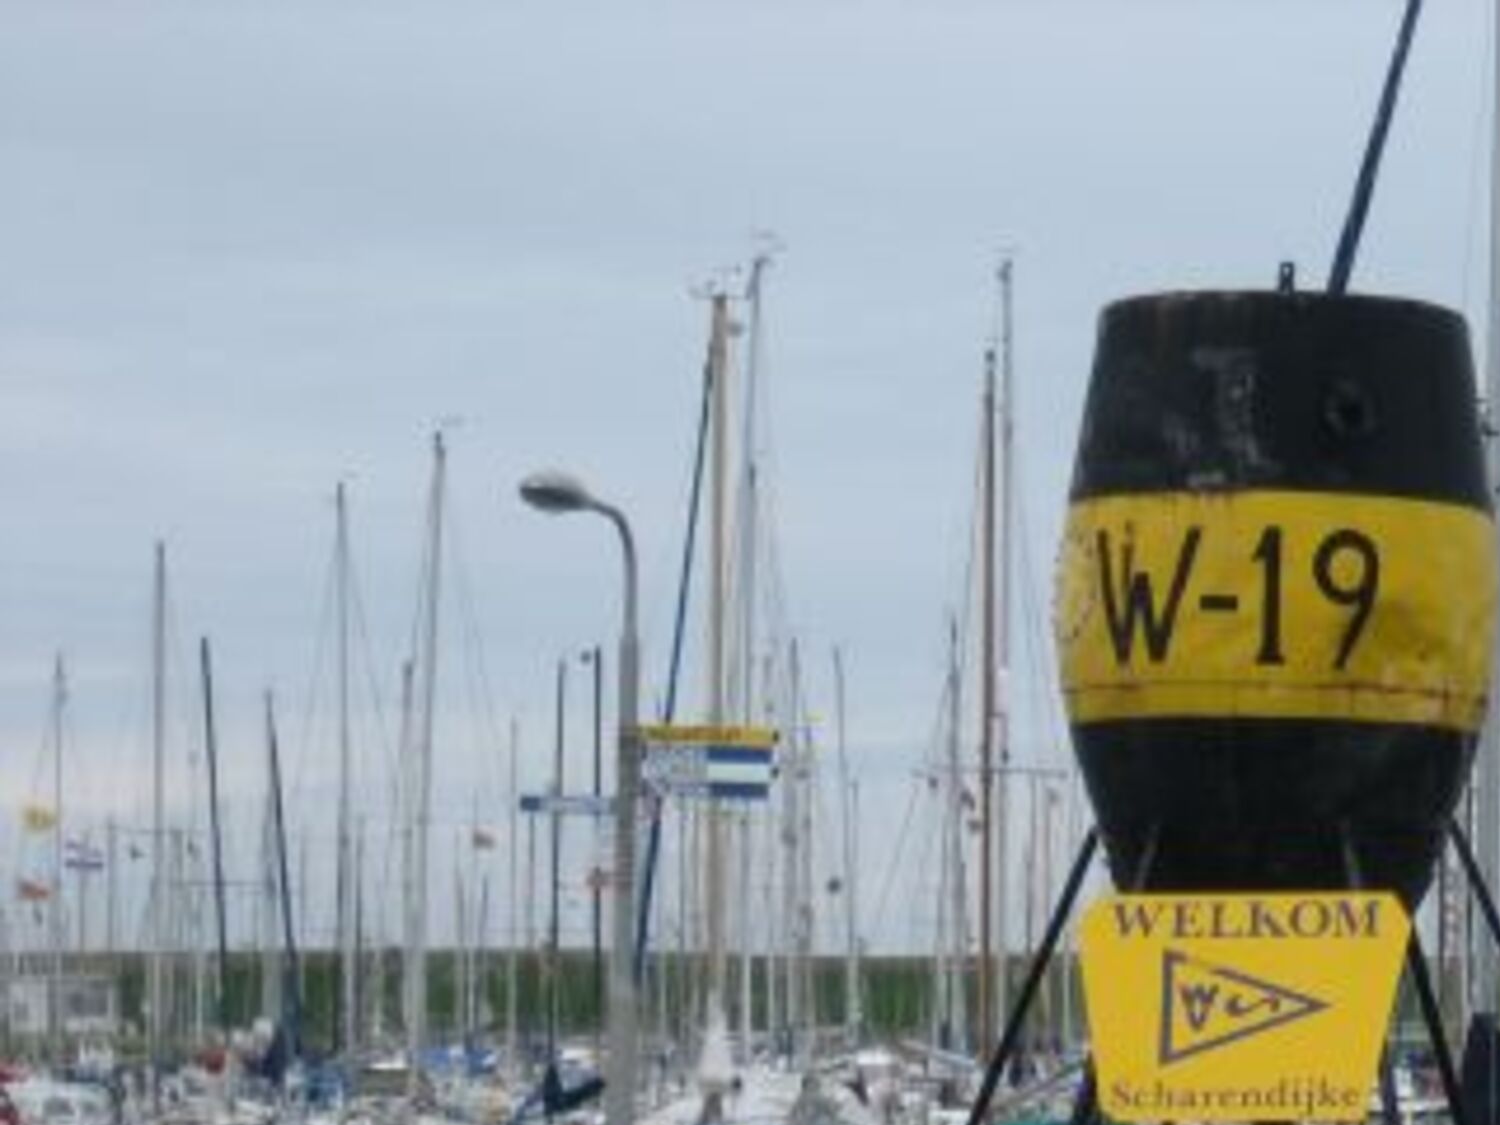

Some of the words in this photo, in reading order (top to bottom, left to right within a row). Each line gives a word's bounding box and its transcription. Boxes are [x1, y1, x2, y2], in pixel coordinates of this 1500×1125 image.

[1096, 523, 1381, 670] W-19
[1112, 900, 1381, 938] WELKOM
[1111, 1077, 1361, 1116] Scharendijke
